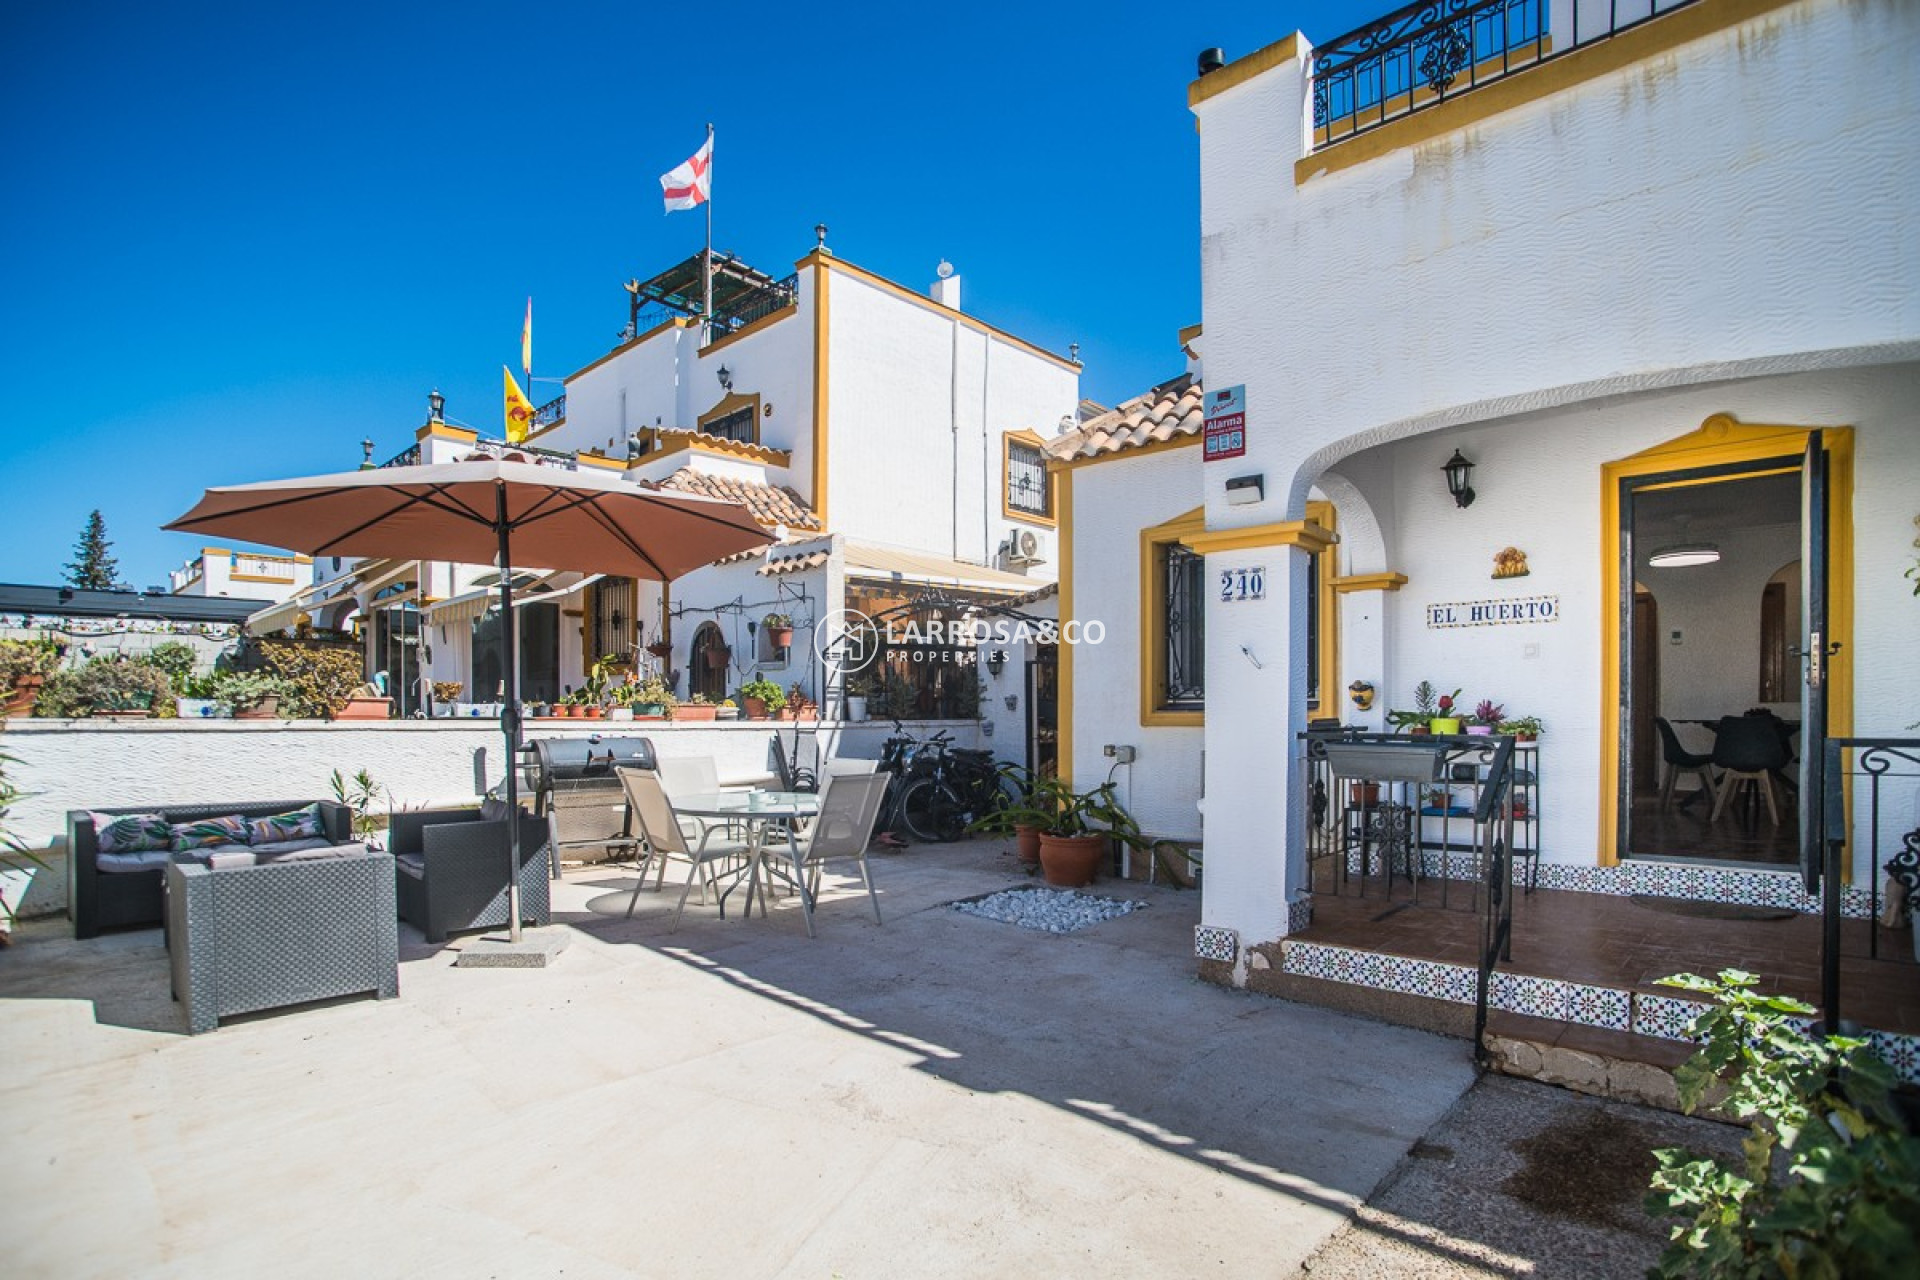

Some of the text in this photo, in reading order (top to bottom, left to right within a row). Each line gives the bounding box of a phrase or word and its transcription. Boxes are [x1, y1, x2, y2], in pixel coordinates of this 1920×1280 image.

[1207, 417, 1242, 430] Alarma
[1221, 574, 1262, 596] 240
[1433, 601, 1553, 624] EL HUERTO
